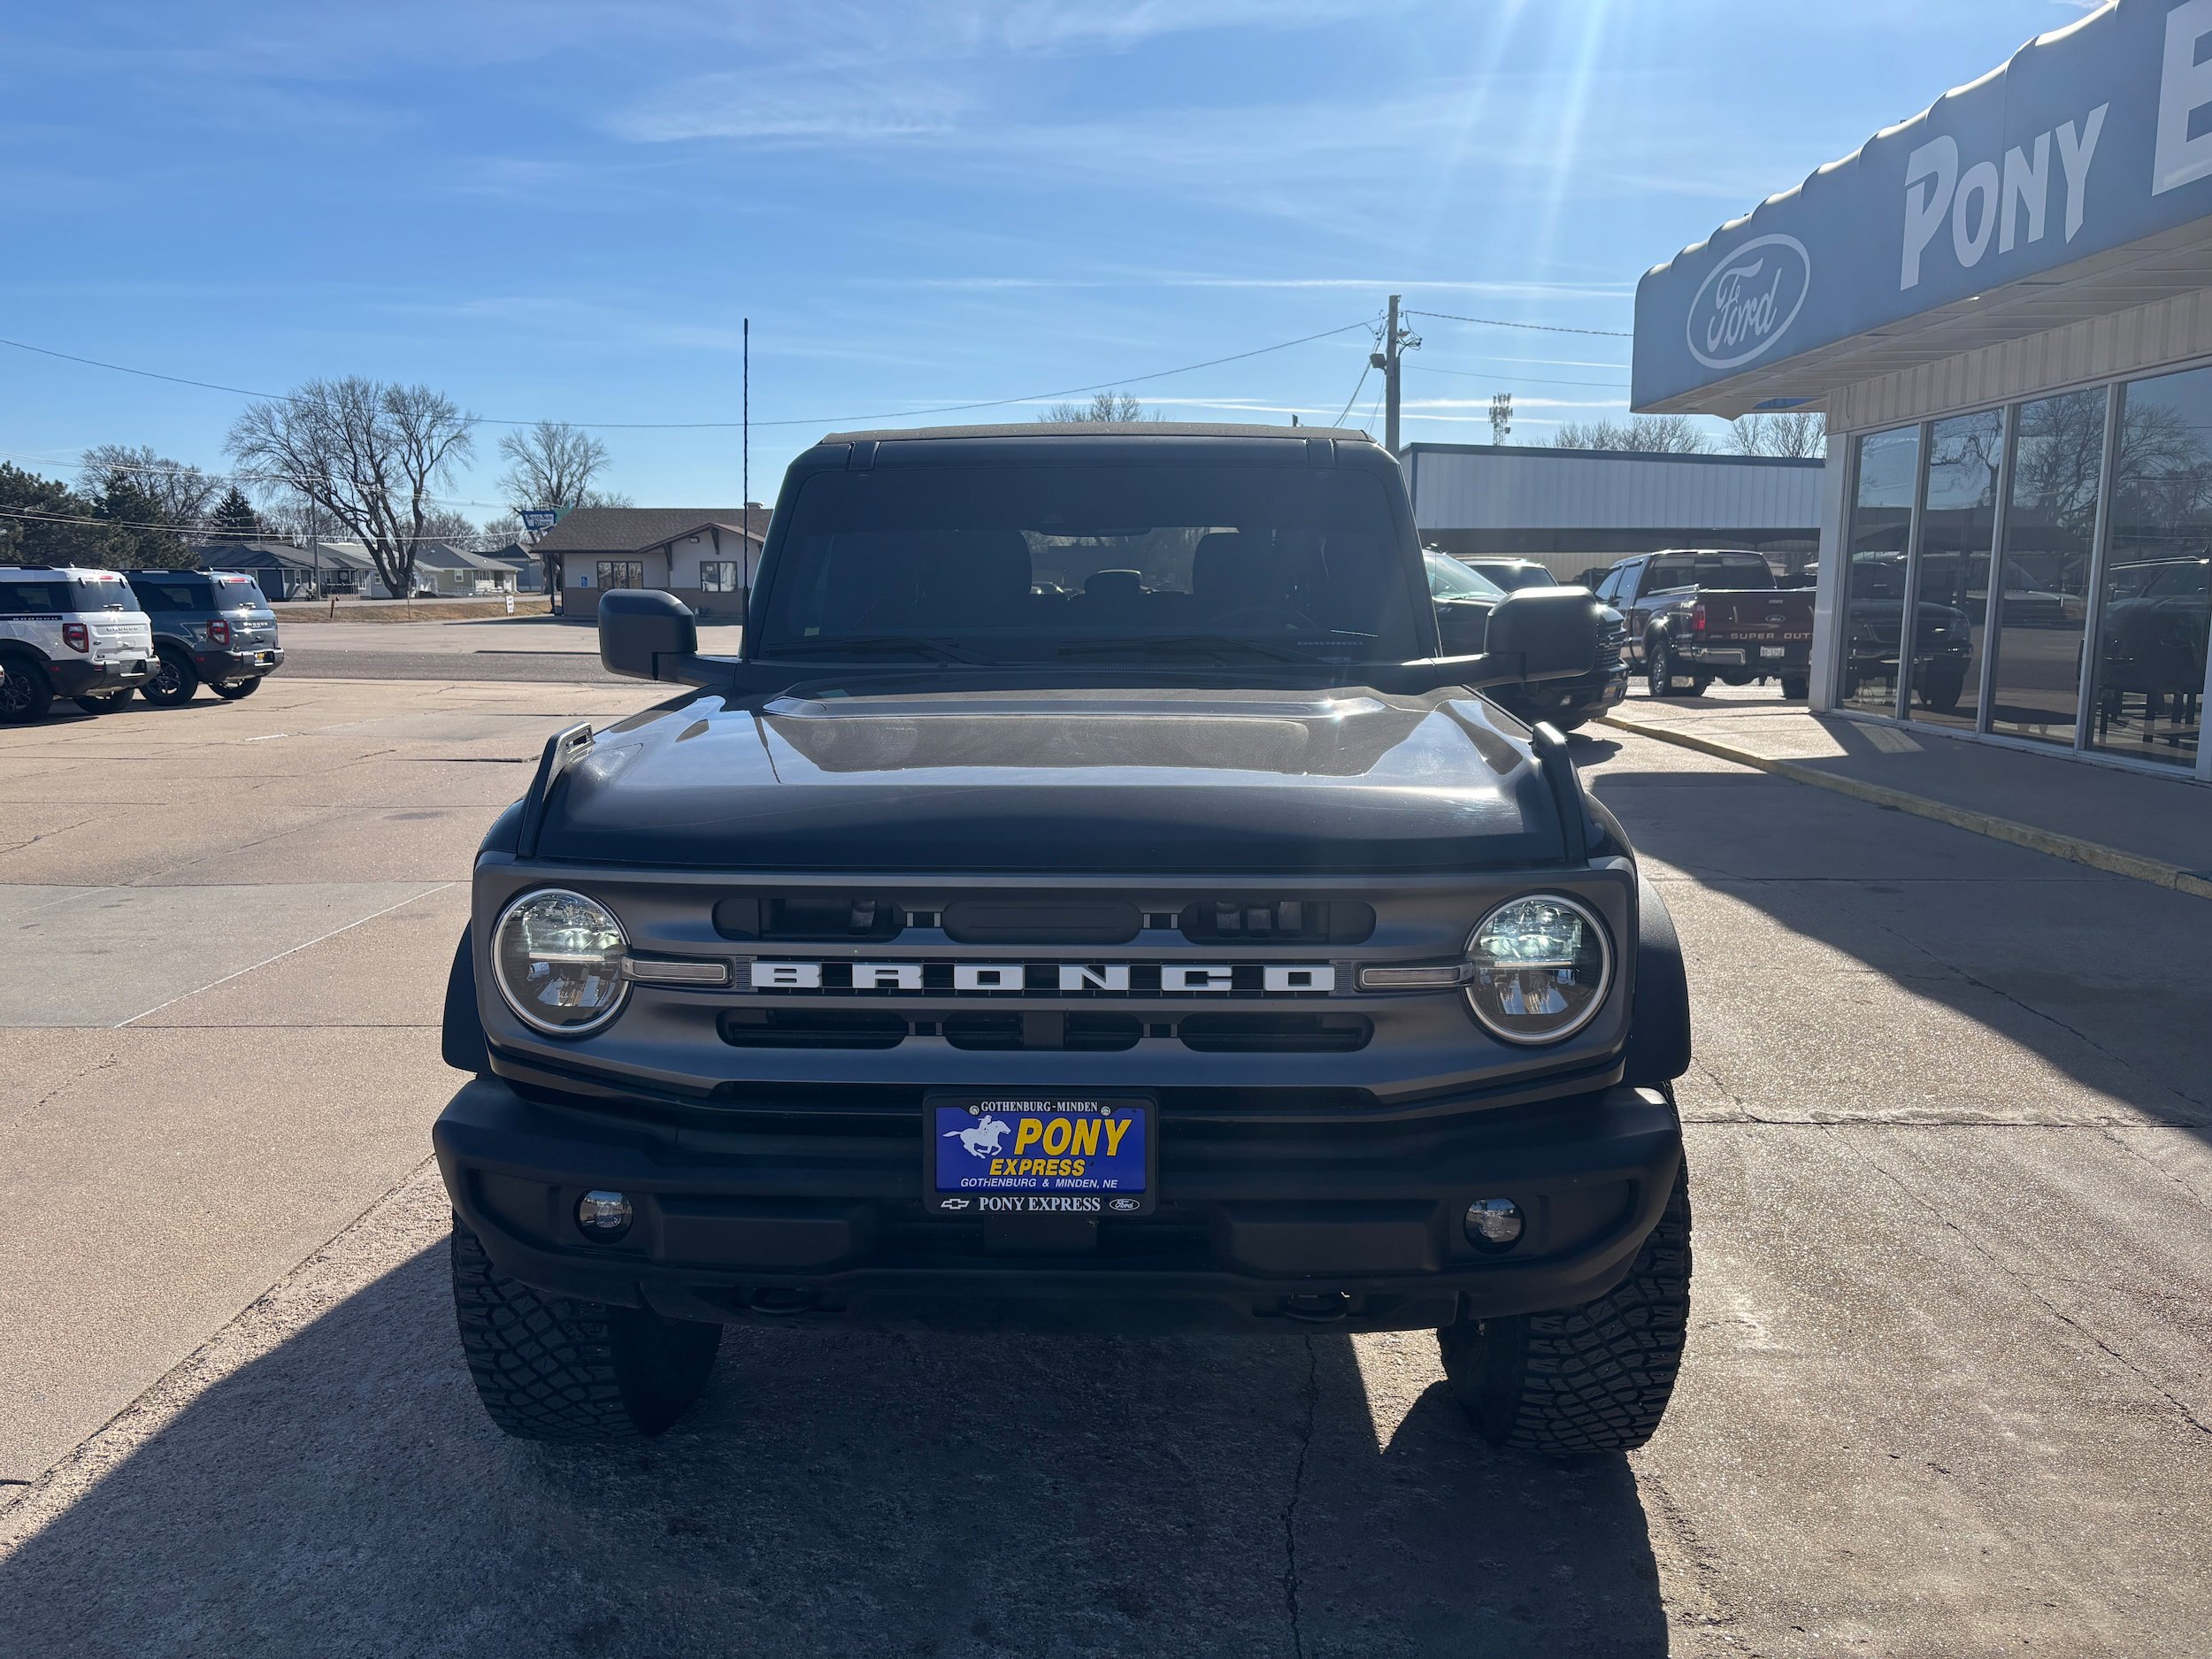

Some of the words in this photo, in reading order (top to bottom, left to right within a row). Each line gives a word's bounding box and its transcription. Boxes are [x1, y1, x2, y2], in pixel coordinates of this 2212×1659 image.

[1901, 102, 2109, 291] PONY
[1707, 257, 1782, 352] Ford
[750, 961, 1336, 992] BRONCO
[980, 1101, 1098, 1112] GOTHENBURG-MINDEN
[1014, 1118, 1133, 1156] PONY
[989, 1158, 1086, 1177] EXPRESS
[960, 1178, 1037, 1188] GOTHENBURG
[1041, 1179, 1050, 1187] &
[1055, 1179, 1100, 1189] MINDEN,
[1102, 1179, 1118, 1188] NE
[978, 1197, 1025, 1211] PONY
[1027, 1197, 1101, 1212] EXPRESS
